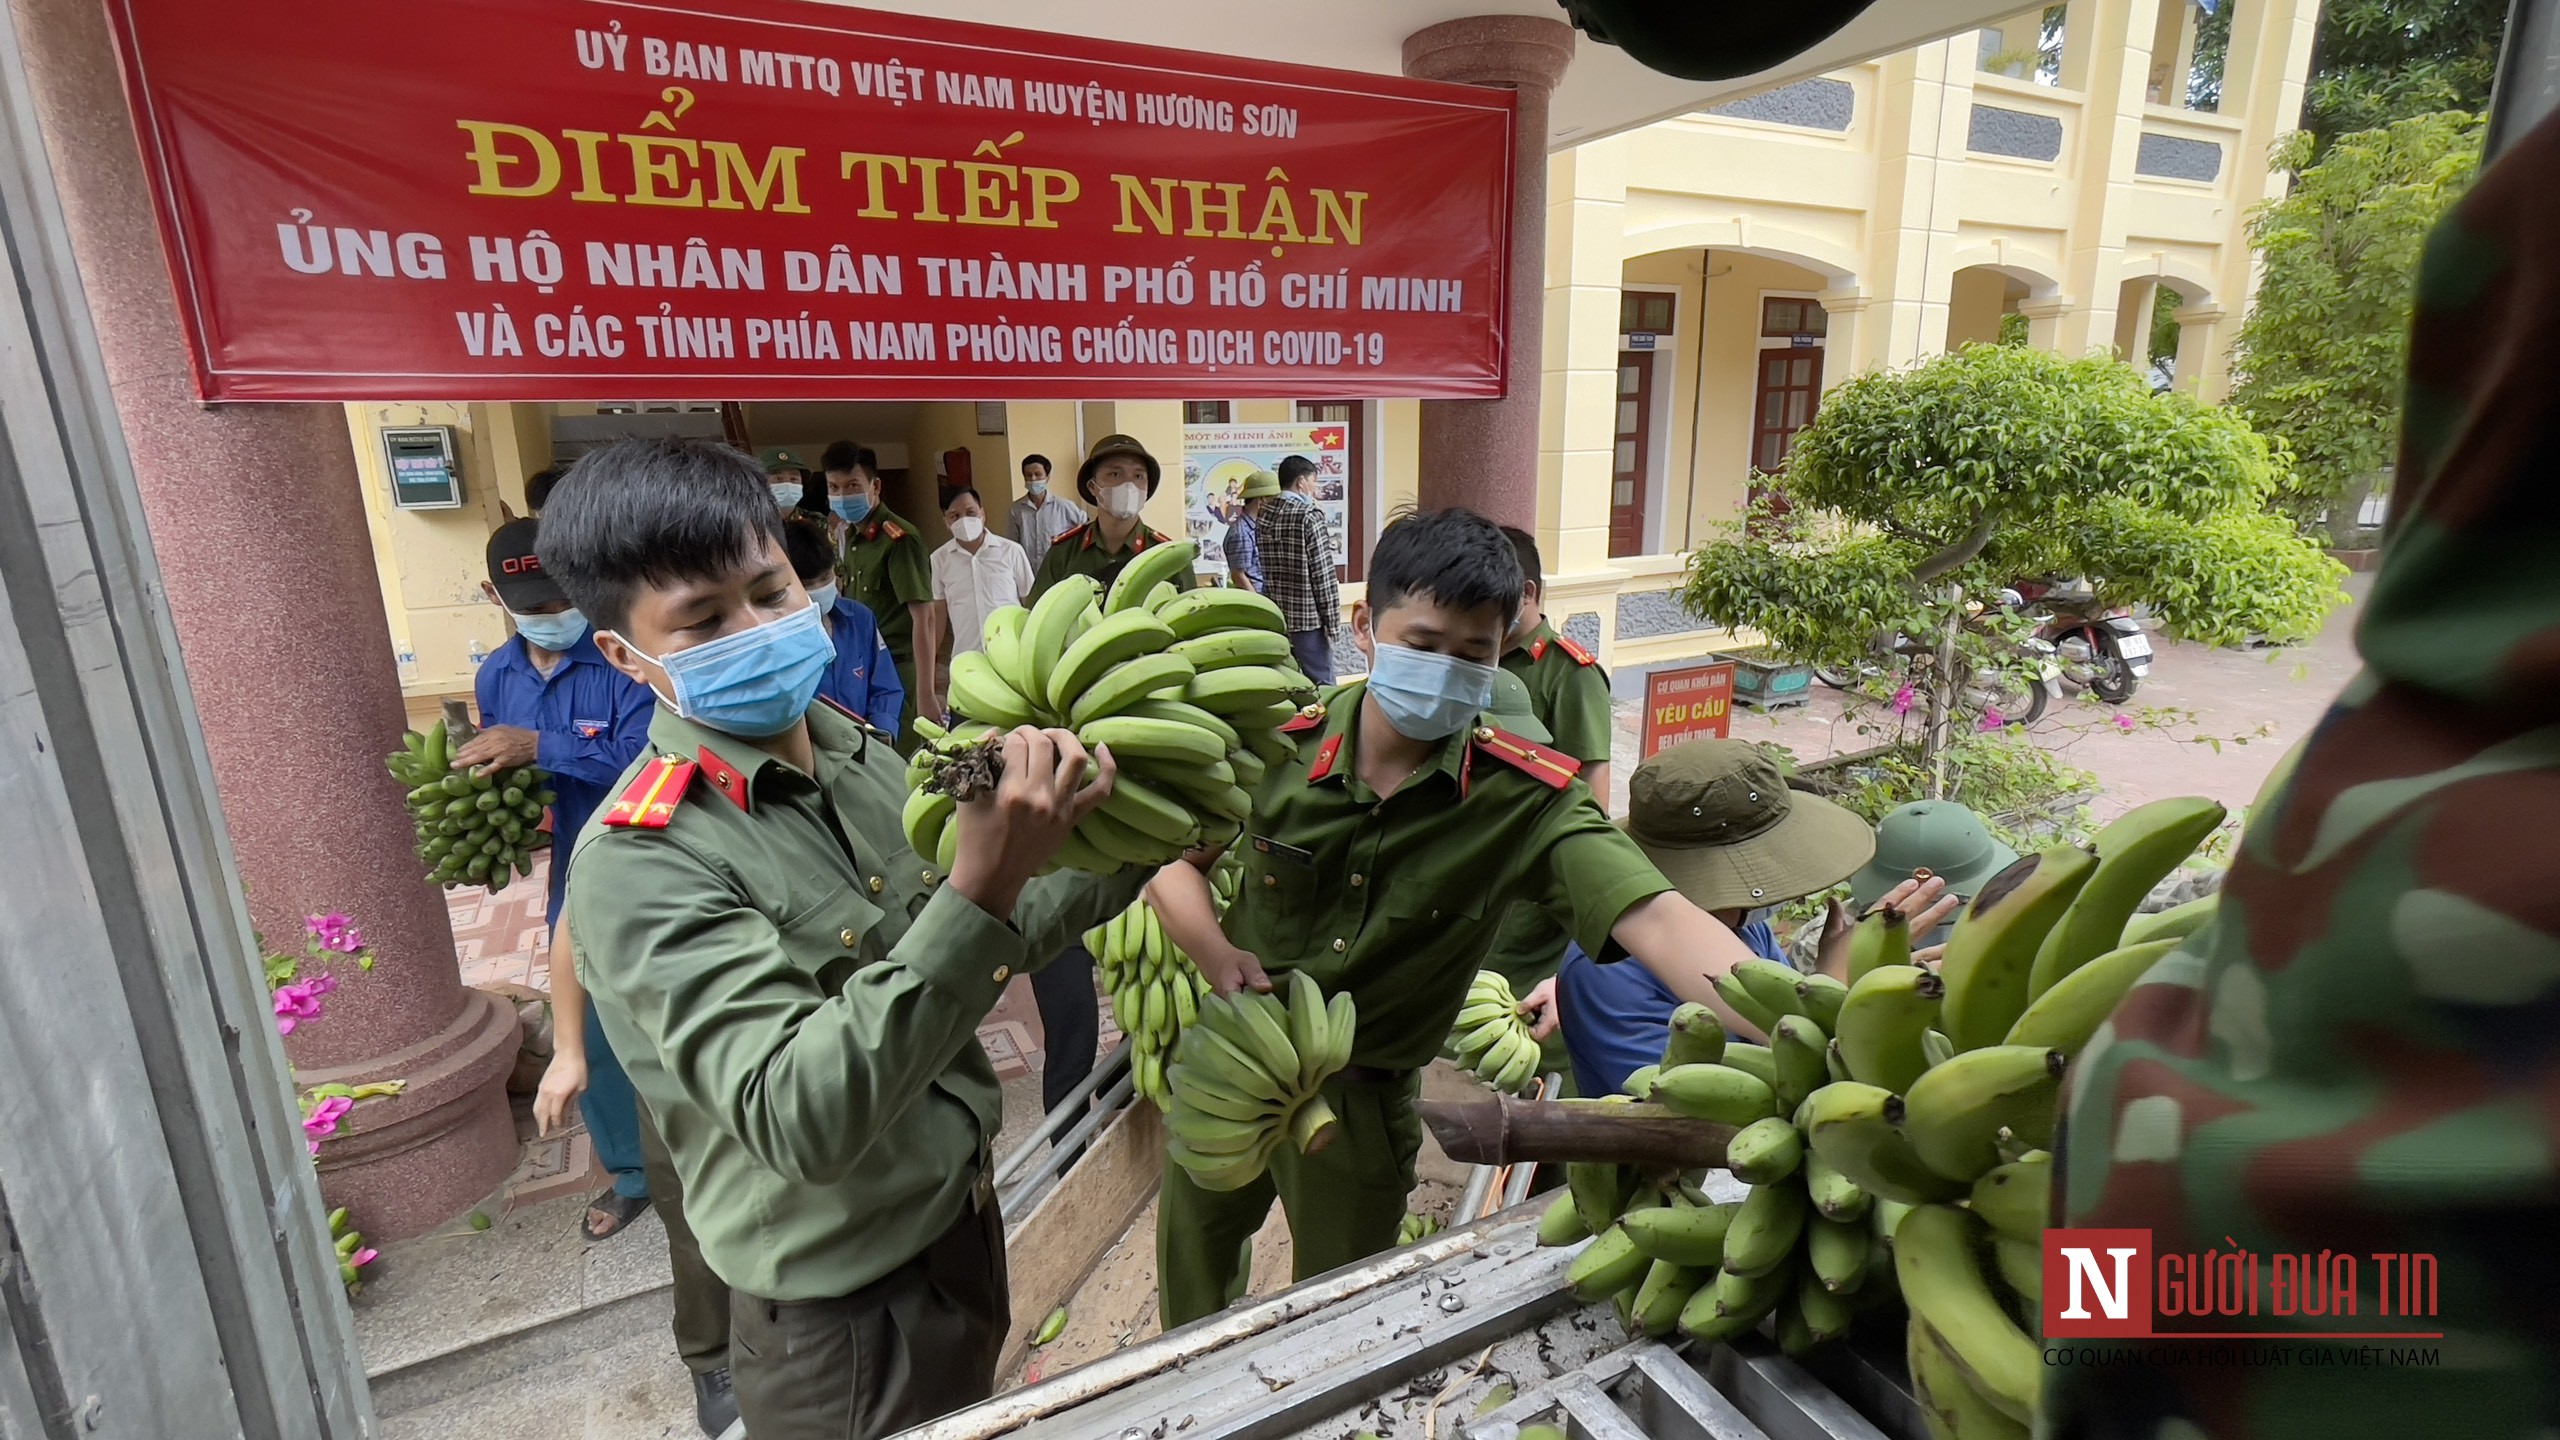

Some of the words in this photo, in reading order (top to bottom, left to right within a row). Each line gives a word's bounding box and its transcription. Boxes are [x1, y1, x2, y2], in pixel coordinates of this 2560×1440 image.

[576, 20, 632, 71] UỶ
[643, 38, 727, 82] BAN
[740, 49, 842, 97] MTTQ
[851, 57, 924, 107] VIỆT
[936, 71, 1014, 110] NAM
[1025, 80, 1127, 126] HUYỆN
[1136, 92, 1233, 135] HƯƠNG
[1242, 104, 1298, 139] SƠN
[457, 87, 810, 214] ĐIỂM
[842, 130, 1080, 229] TIẾP
[1111, 167, 1369, 258] NHẬN
[277, 207, 446, 280] ỦNG
[469, 229, 563, 294] HỘ
[586, 237, 764, 291] NHÂN
[784, 244, 902, 298] DÂN
[918, 251, 1087, 303] THÀNH
[1104, 255, 1196, 306] PHỐ
[1210, 259, 1266, 308] HỒ
[1281, 267, 1348, 309] CHÍ
[1362, 277, 1462, 313] MINH
[456, 303, 523, 358] VÀ
[535, 306, 624, 358] CÁC
[636, 302, 734, 359] TỈNH
[746, 311, 840, 361] PHÍA
[850, 321, 935, 362] NAM
[947, 316, 1061, 363] PHÒNG
[1072, 316, 1177, 365] CHỐNG
[1187, 329, 1254, 373] DỊCH
[1264, 331, 1384, 367] COVID-19
[1184, 432, 1211, 441] MỘT
[1214, 431, 1230, 441] SỐ
[1233, 432, 1264, 440] HÌNH
[1268, 430, 1293, 440] ẢNH
[1655, 703, 1687, 725] YÊU
[1657, 681, 1668, 693] CƠ
[1670, 679, 1690, 693] QUAN
[1691, 673, 1709, 688] KHỐI
